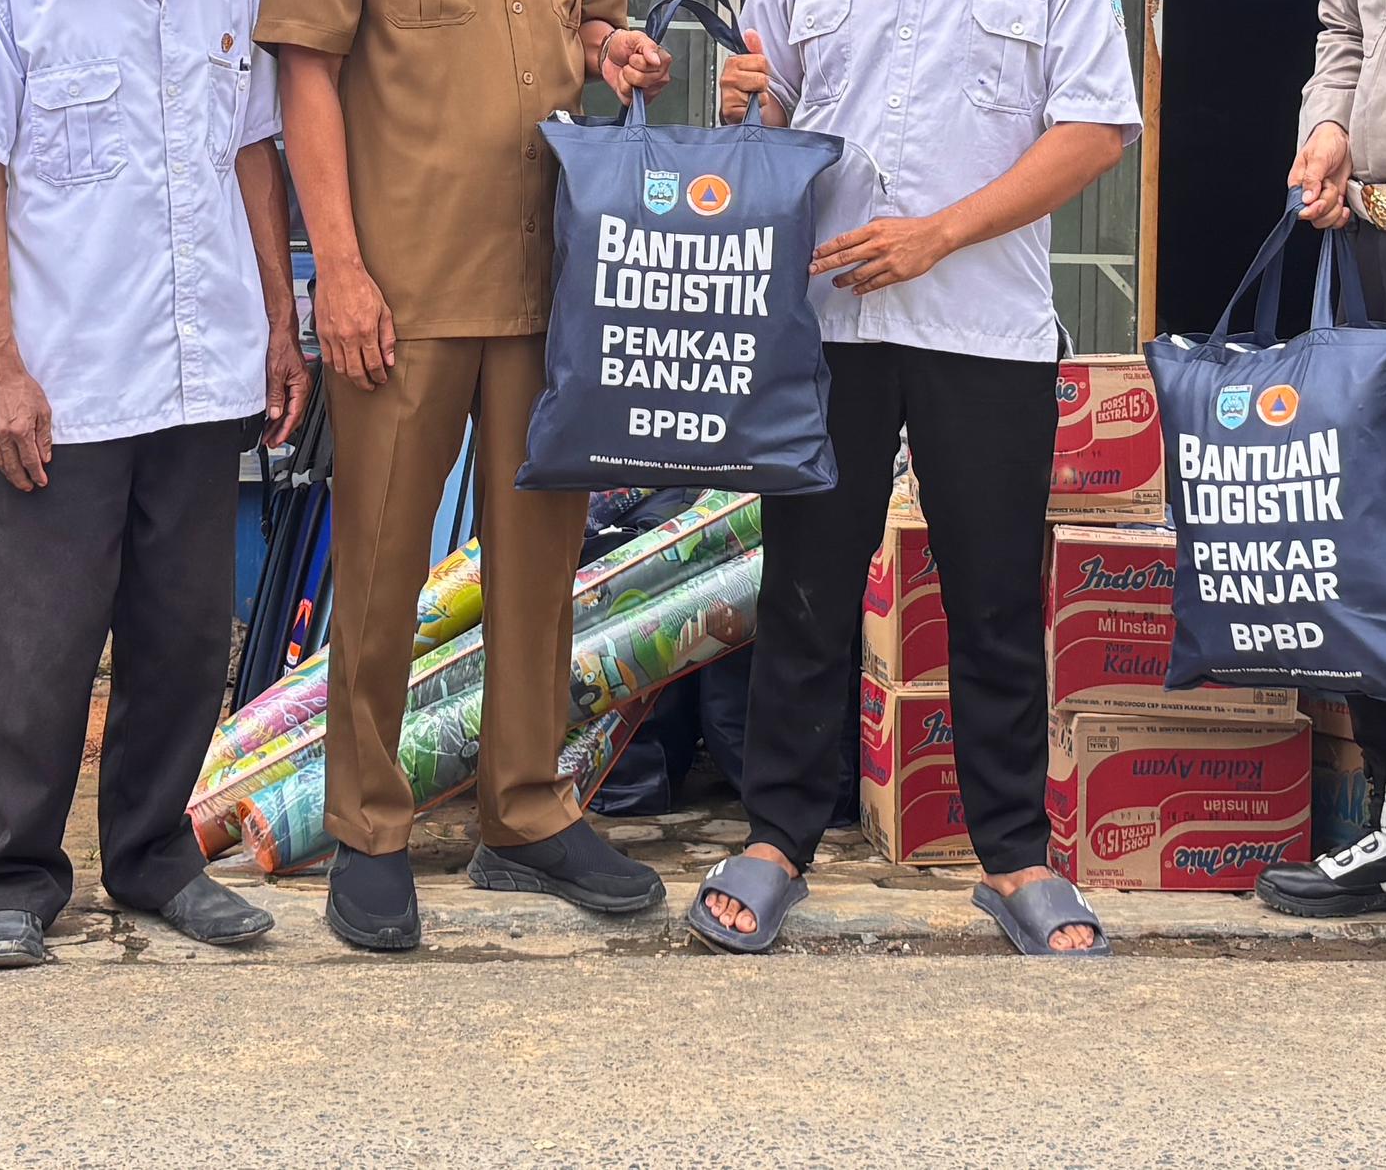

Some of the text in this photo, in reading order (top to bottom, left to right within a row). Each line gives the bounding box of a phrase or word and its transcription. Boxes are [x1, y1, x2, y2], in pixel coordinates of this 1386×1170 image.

[598, 214, 773, 272] BANTUAN
[594, 262, 771, 317] LOGISTIK
[601, 325, 756, 362] PEMKAB
[600, 357, 753, 395] BANJAR
[1097, 391, 1150, 422] EKSTRA 15%
[1102, 395, 1127, 410] PORSI
[628, 407, 727, 443] BPBD
[1178, 428, 1341, 482] BANTUAN
[1181, 477, 1344, 524] LOGISTIK
[1193, 538, 1338, 572] PEMKAB
[1198, 571, 1341, 606] BANJAR
[1098, 618, 1167, 635] Mi Instan
[1230, 621, 1325, 652] BPBD
[1132, 754, 1263, 781] Kaldu Ayam
[1203, 799, 1269, 814] Mi Instan
[1097, 823, 1154, 856] EKSTRA 15%
[1122, 834, 1151, 850] PORSI
